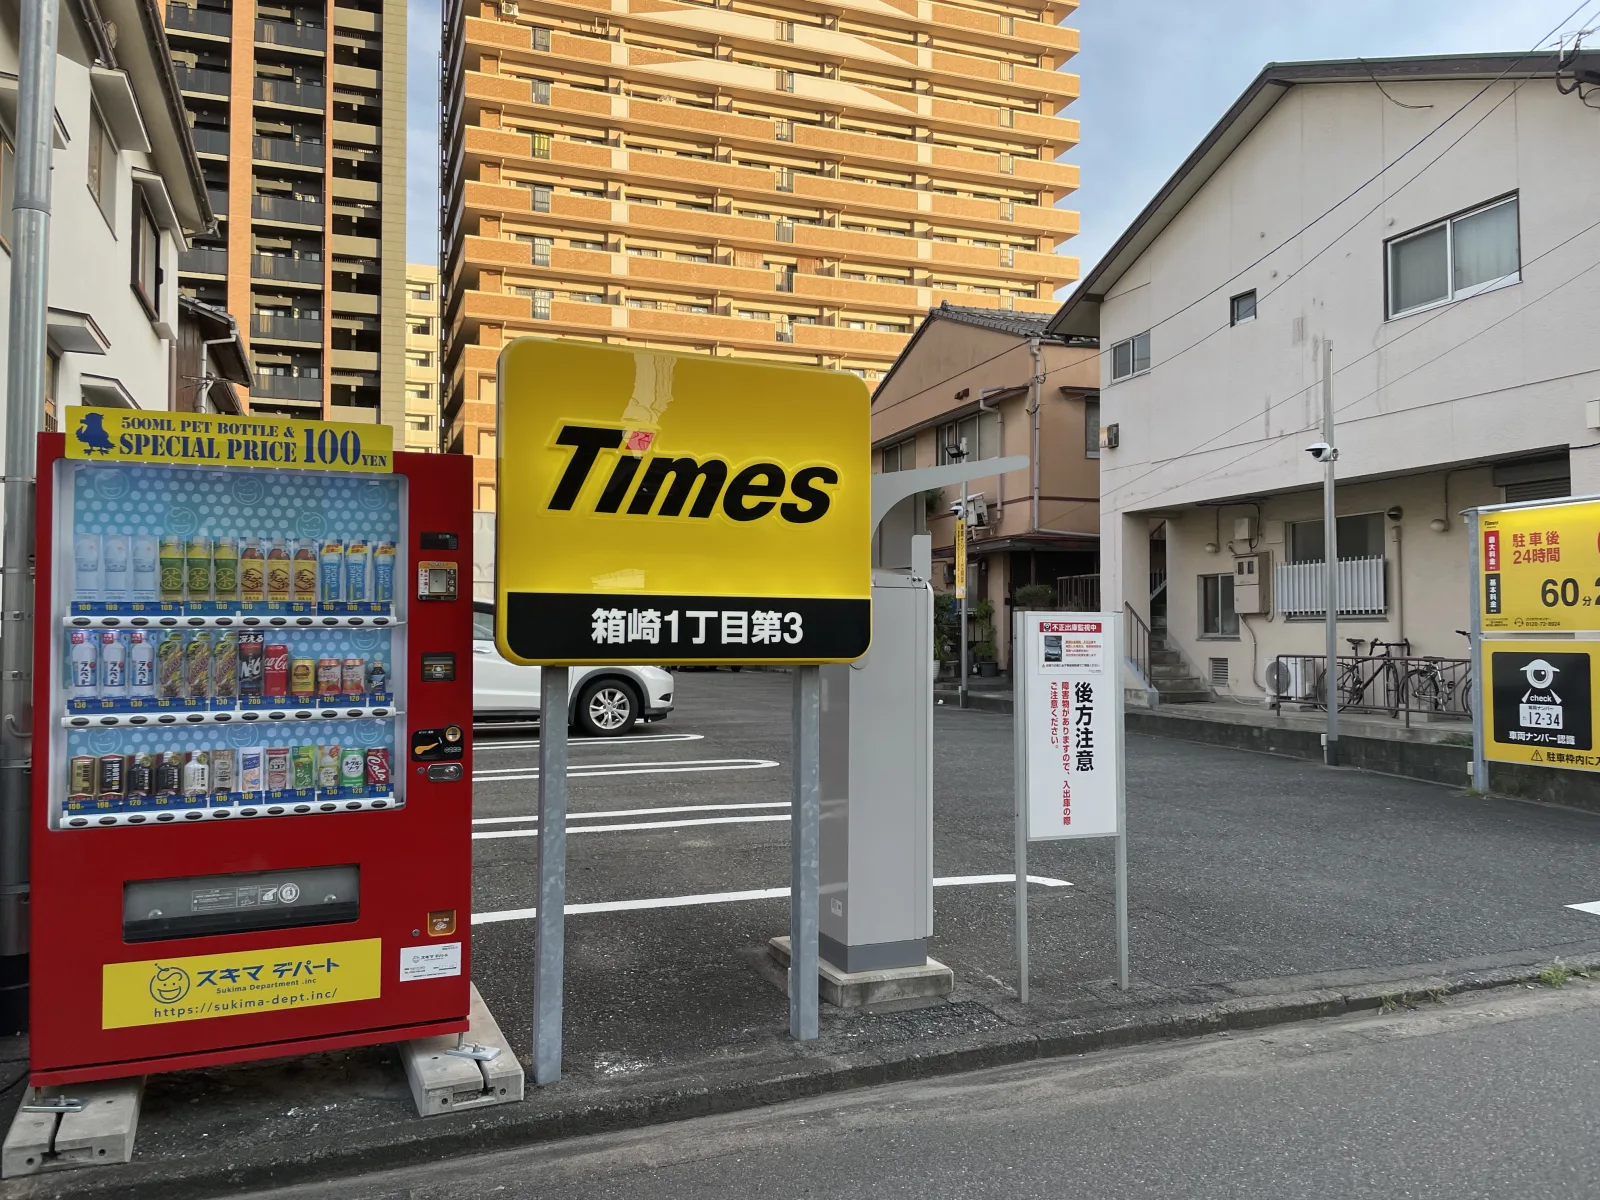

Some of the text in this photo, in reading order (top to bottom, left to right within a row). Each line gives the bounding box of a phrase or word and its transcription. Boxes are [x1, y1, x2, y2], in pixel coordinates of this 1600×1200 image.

[121, 416, 295, 439] 500ML PET BOTTLE &
[119, 433, 297, 463] SPECIAL PRICE
[303, 428, 387, 467] 100 YEN
[547, 424, 838, 525] Times
[1488, 536, 1496, 565] 最大料金
[1512, 530, 1560, 548] 駐車後
[1513, 547, 1560, 564] 24時間
[590, 607, 804, 645] 箱崎1丁目第3
[1530, 694, 1552, 702] check
[1050, 682, 1059, 749] ご注意ください。
[1074, 681, 1094, 772] 後方注意
[1529, 712, 1560, 726] 12-34
[1508, 730, 1576, 746] 車両ナンバー認識
[196, 958, 340, 988] スキマ デパート
[216, 985, 247, 994] Sukima
[250, 980, 299, 991] Department
[154, 987, 338, 1018] https://sukima-dept.inc/
